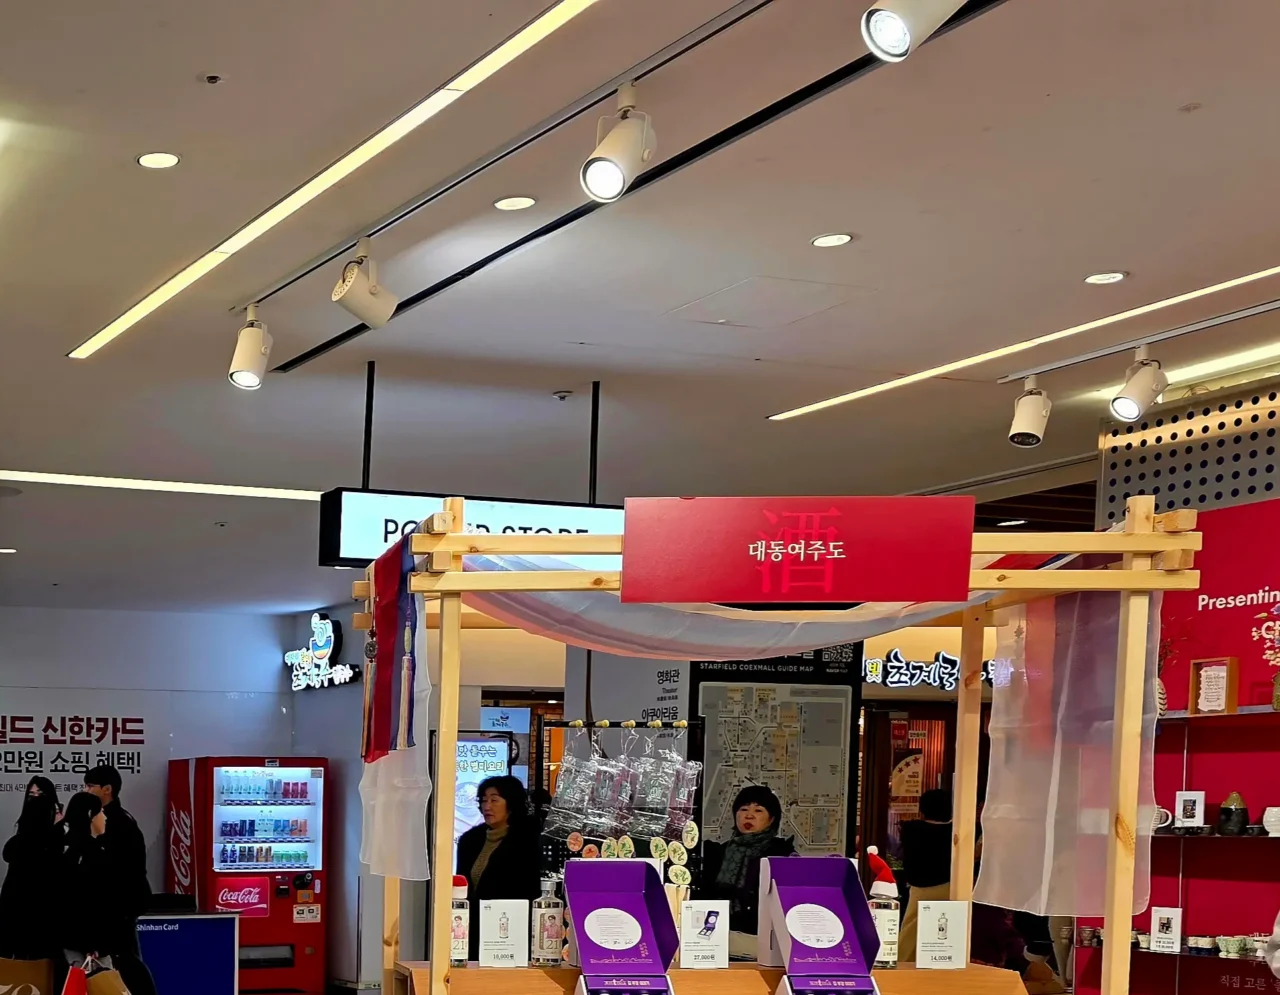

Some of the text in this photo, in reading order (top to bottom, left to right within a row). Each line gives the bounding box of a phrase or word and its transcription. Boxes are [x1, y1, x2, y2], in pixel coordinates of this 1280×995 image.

[748, 539, 846, 562] 대동여주도
[657, 669, 680, 685] 영화관
[641, 706, 679, 722] 아쿠아리움
[41, 715, 145, 746] 신한카드
[49, 751, 90, 774] 쇼핑
[163, 923, 179, 931] Card
[1220, 974, 1241, 988] 직접
[1243, 977, 1267, 991] 고른
